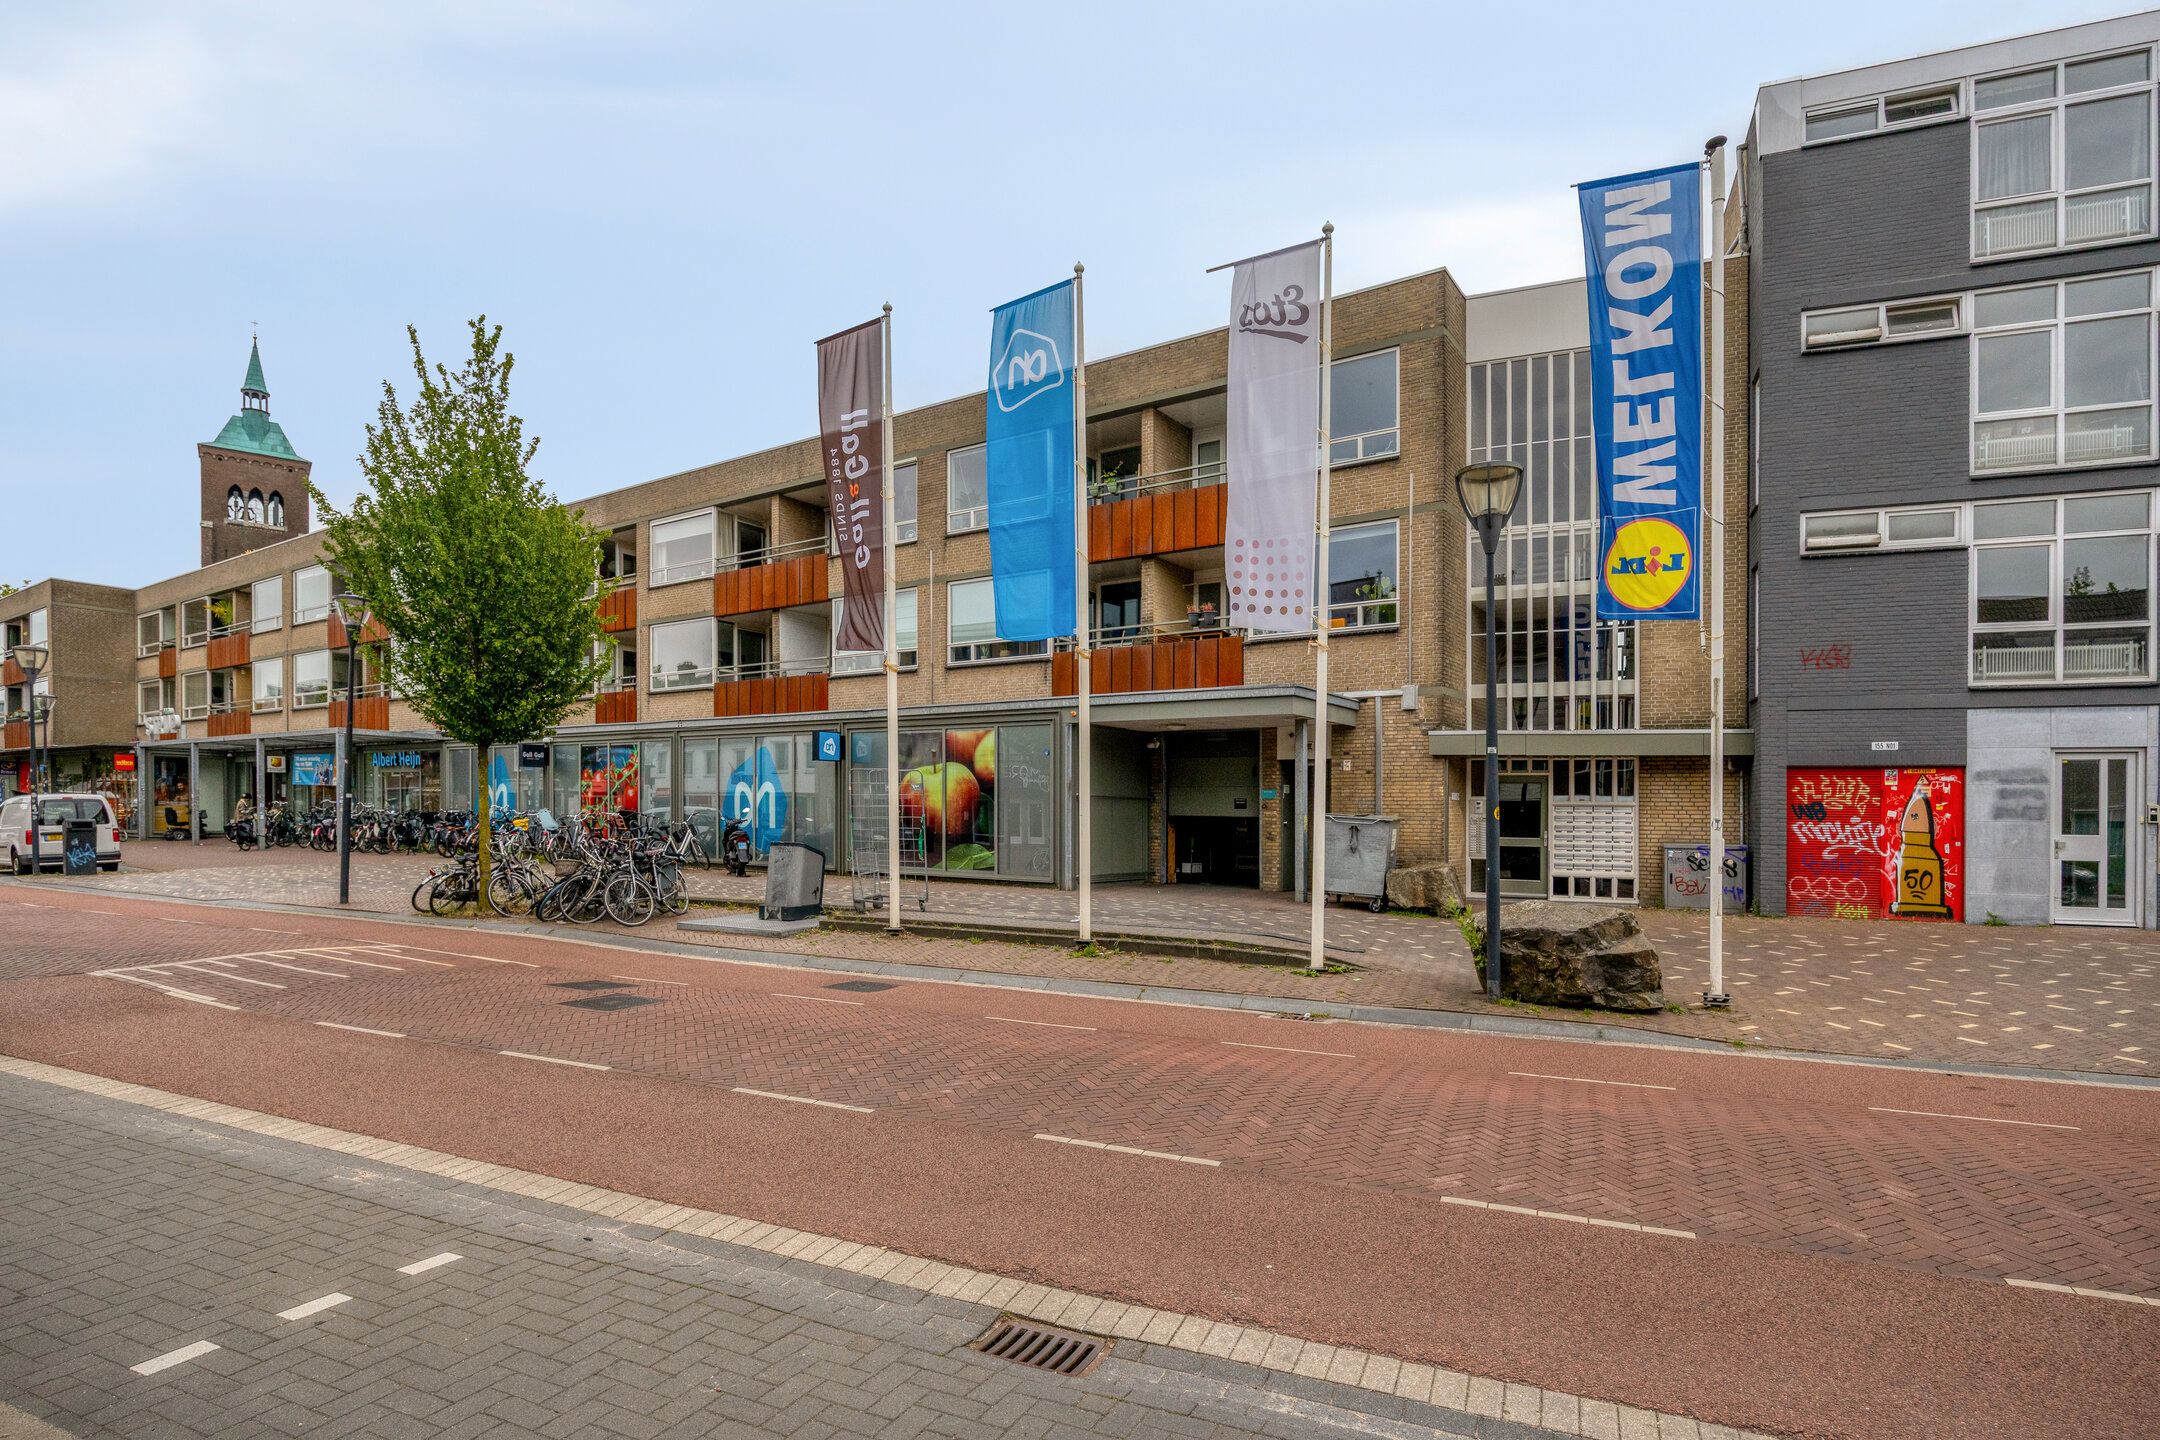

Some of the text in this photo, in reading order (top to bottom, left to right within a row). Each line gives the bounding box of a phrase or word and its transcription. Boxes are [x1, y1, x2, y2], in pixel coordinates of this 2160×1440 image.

[372, 752, 421, 769] Albert Heijn
[1904, 869, 1932, 891] 50
